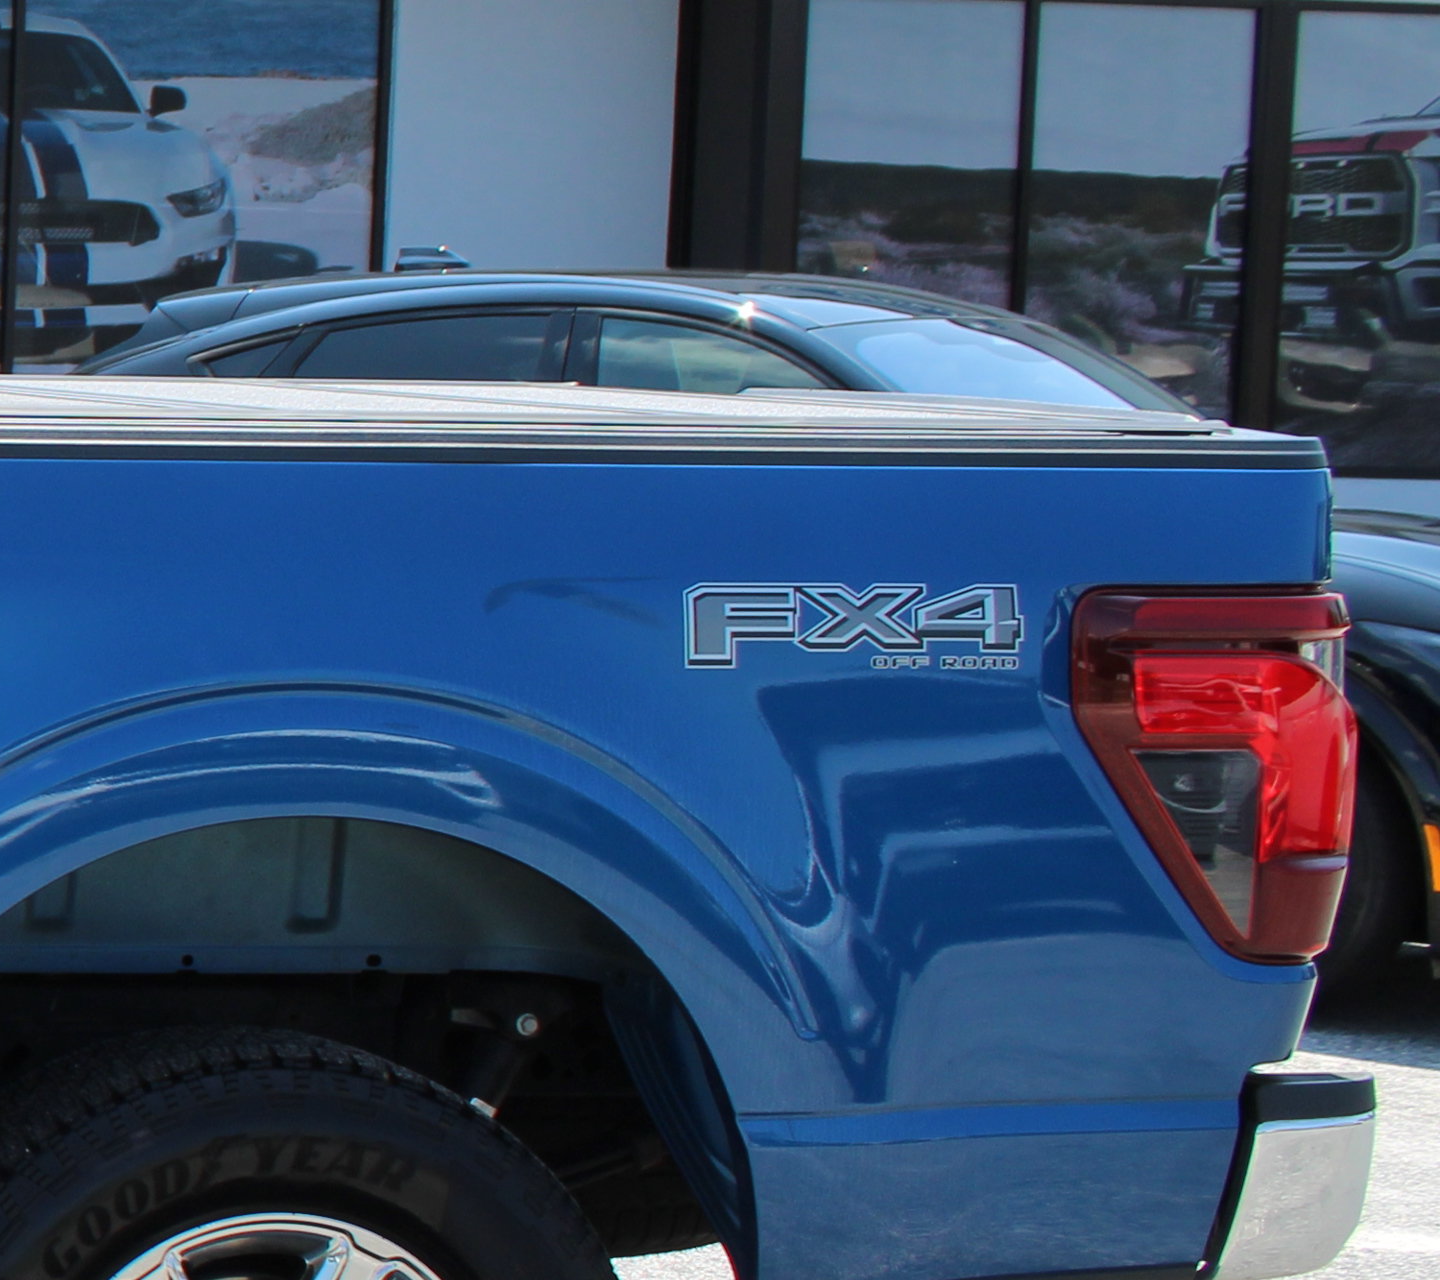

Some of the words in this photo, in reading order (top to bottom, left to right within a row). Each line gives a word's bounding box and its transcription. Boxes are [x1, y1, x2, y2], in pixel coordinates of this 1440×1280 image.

[1219, 192, 1384, 219] FRD
[683, 582, 1024, 669] FX4
[870, 654, 930, 670] OFF
[939, 654, 1019, 671] ROAD
